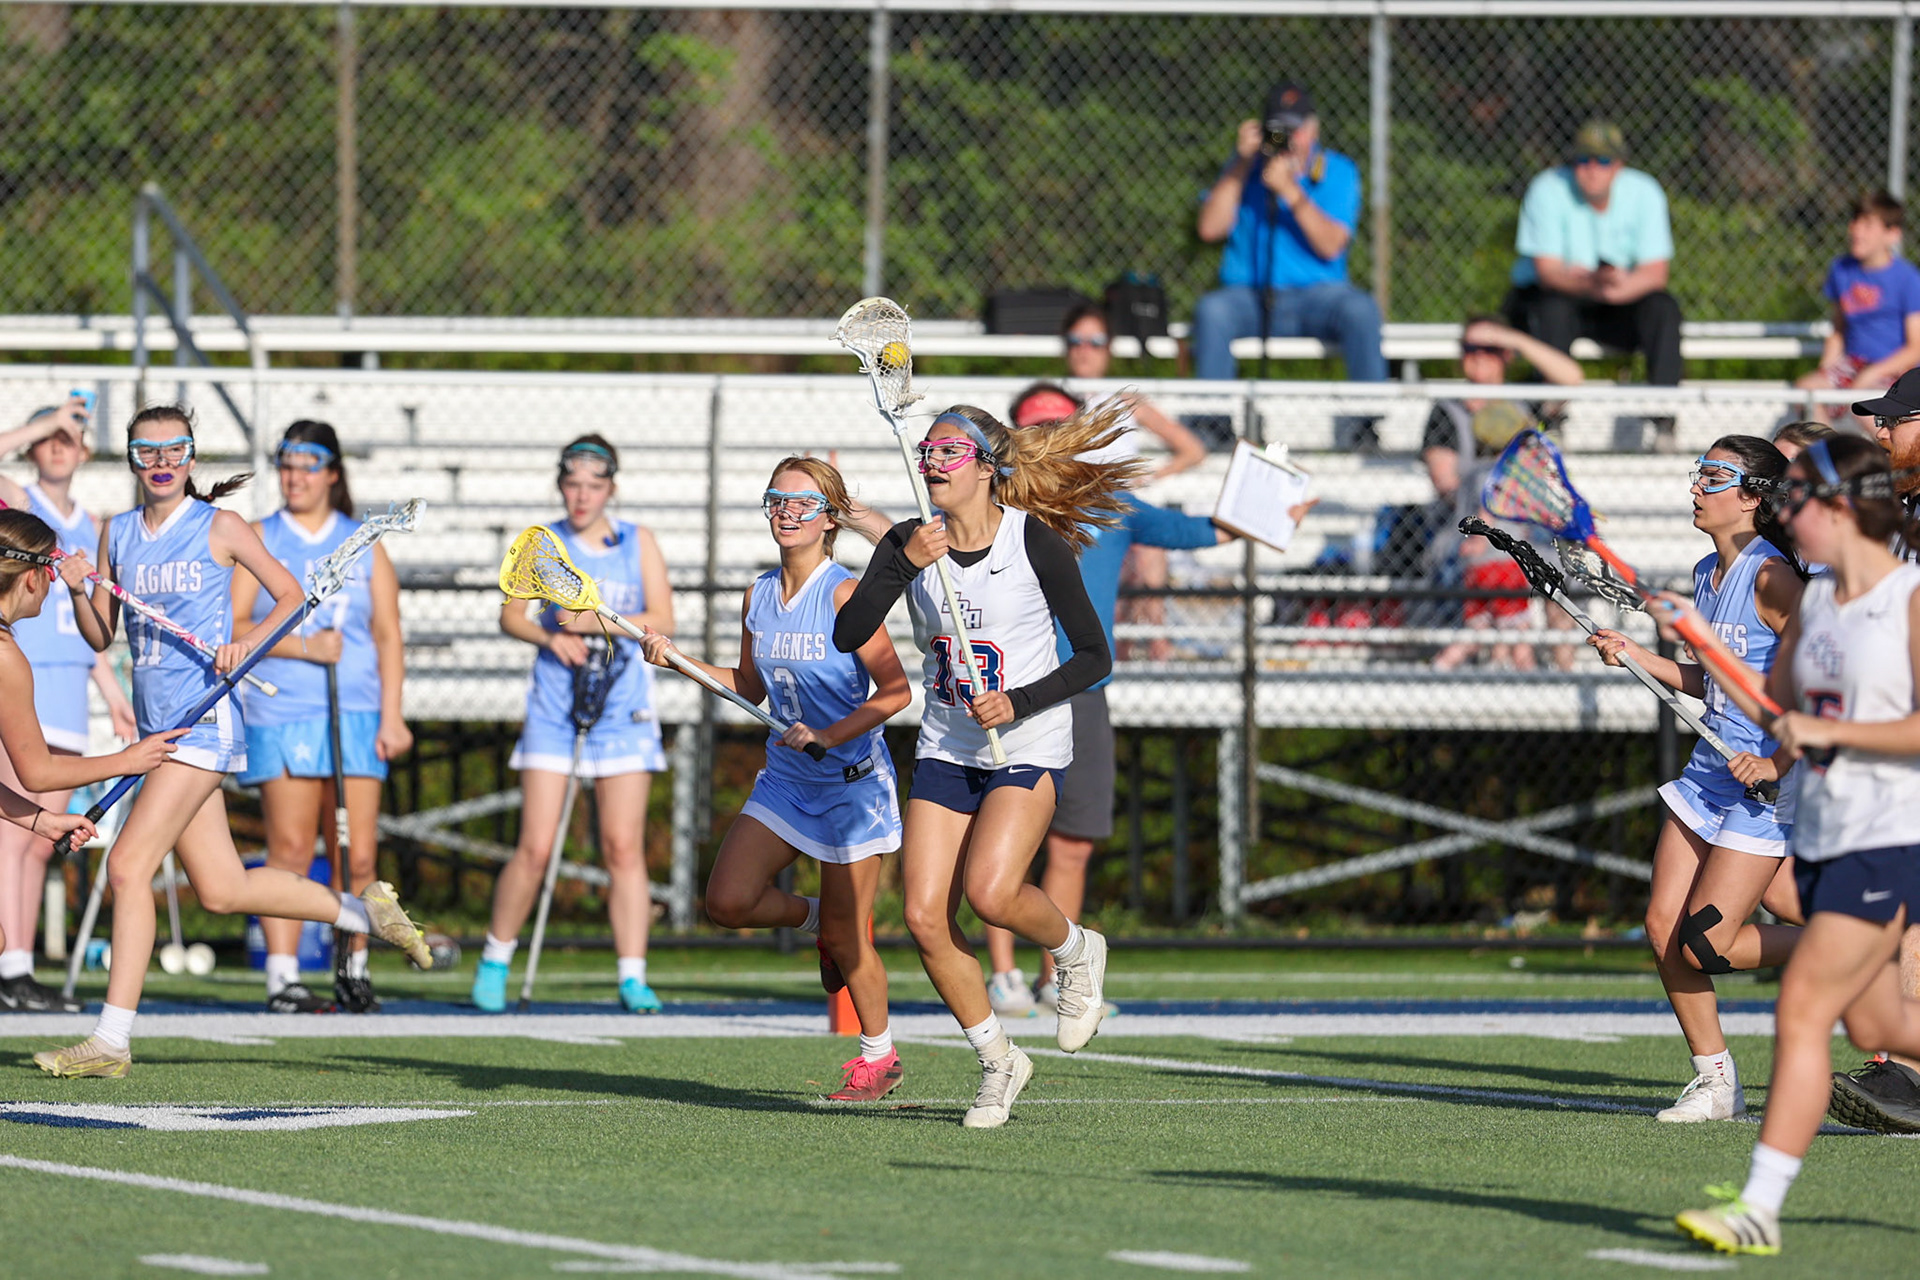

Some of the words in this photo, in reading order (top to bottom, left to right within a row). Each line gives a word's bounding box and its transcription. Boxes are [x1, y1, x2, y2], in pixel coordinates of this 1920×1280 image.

[1748, 476, 1772, 487] STX
[4, 549, 32, 562] STX
[133, 560, 202, 595] AGNES
[770, 631, 826, 661] AGNES
[930, 635, 1004, 708] 13
[773, 667, 804, 721] 3
